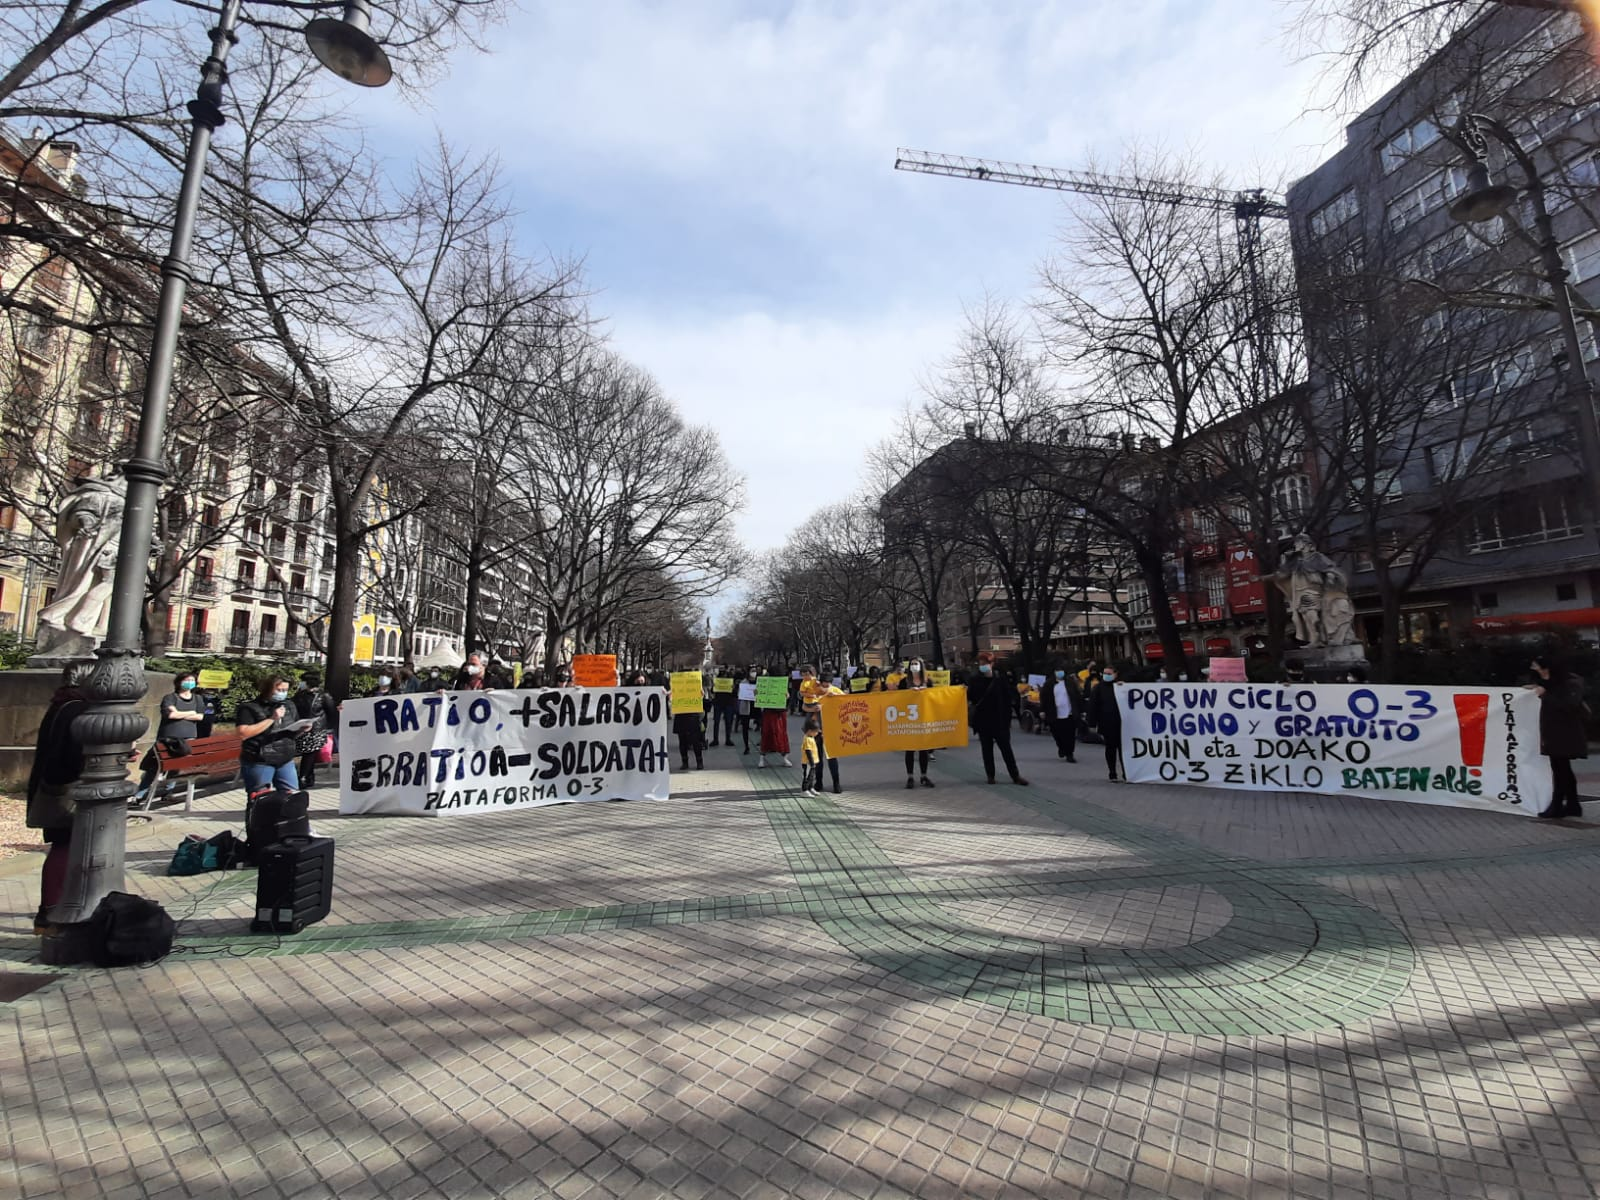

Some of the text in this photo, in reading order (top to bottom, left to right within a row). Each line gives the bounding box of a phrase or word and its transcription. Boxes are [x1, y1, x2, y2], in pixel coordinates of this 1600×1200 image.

[885, 704, 919, 722] 0-3
[1128, 687, 1182, 711] POR
[1183, 689, 1218, 710] UN
[1346, 688, 1439, 721] 0-3
[1204, 736, 1240, 758] eta
[1254, 739, 1371, 765] DOAKO
[1501, 692, 1519, 793] PLATAFORMA
[1159, 761, 1210, 783] 0-3
[1341, 766, 1433, 793] BATEN
[424, 777, 604, 811] PLATAFORMA 0-3
